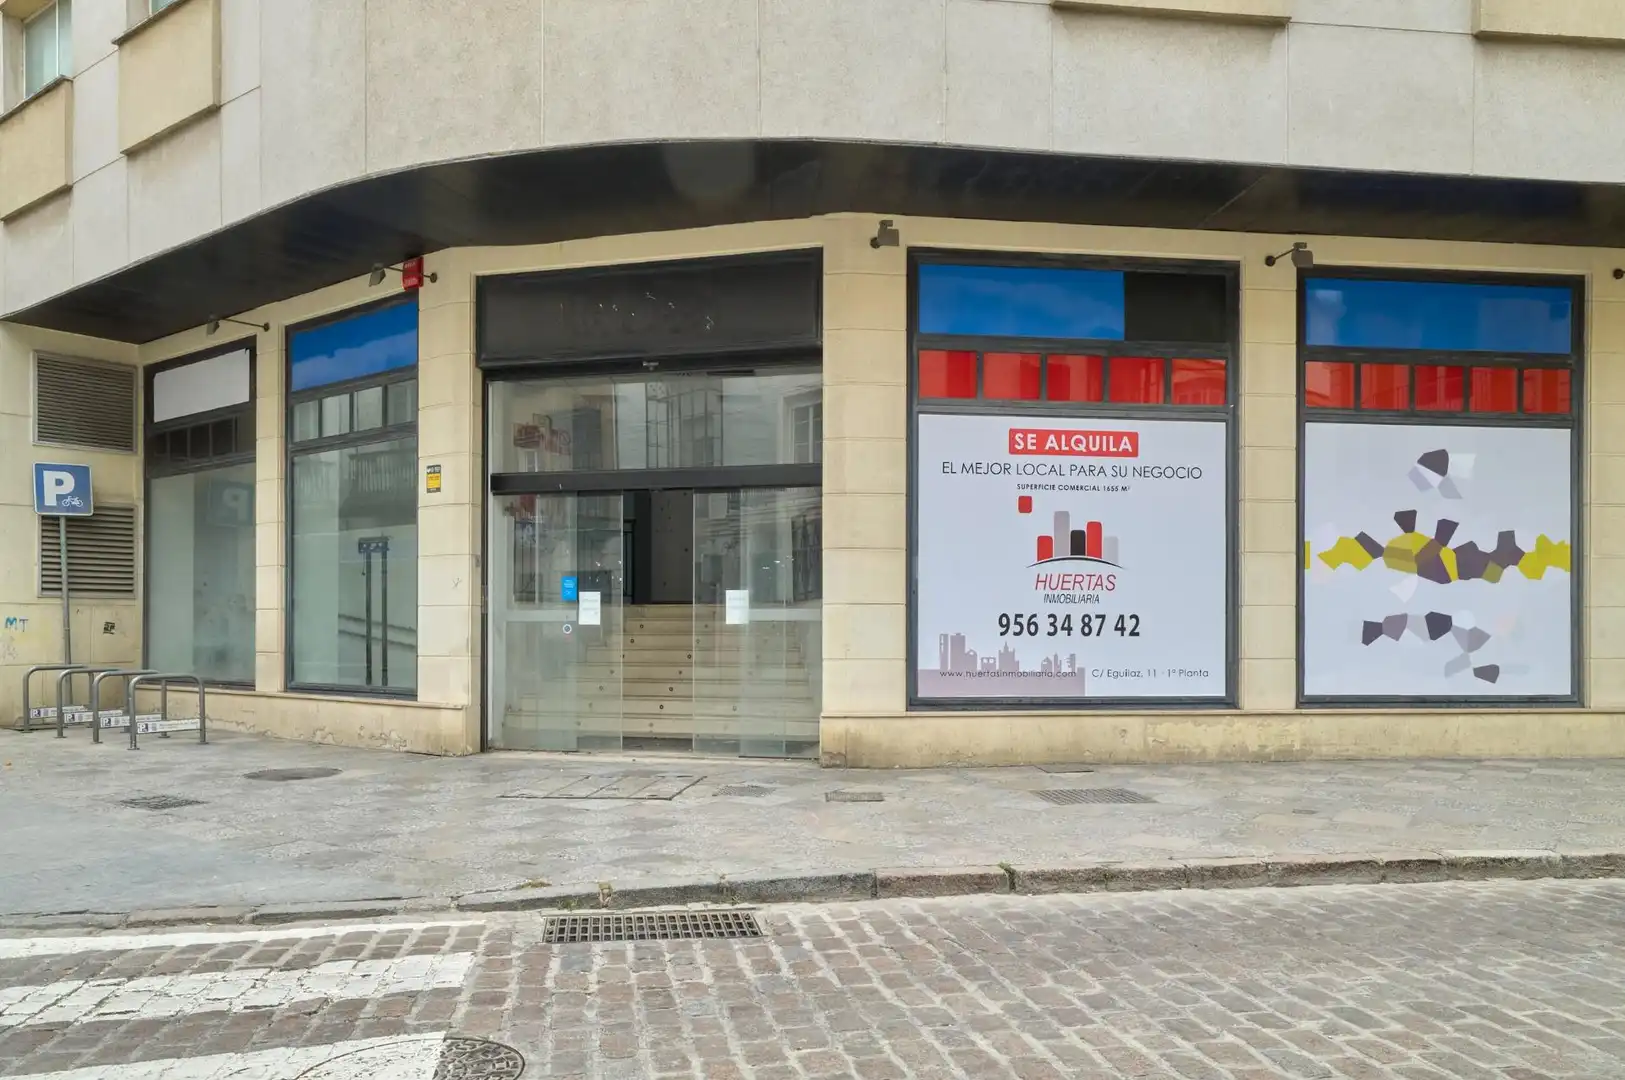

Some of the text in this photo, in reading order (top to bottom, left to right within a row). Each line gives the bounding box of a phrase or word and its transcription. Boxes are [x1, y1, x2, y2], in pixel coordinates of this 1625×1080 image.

[1014, 432, 1133, 453] SE ALQUILA
[942, 461, 1203, 480] EL MEJOR LOCAL PARA SU NEGOCIO
[43, 470, 75, 506] P
[1016, 483, 1056, 491] SUPERFICIE
[1057, 484, 1101, 492] COMERCIAL
[1034, 573, 1117, 592] HUERTAS
[1043, 593, 1100, 604] INMOBILIARIA
[998, 613, 1140, 637] 956 34 87 42
[939, 669, 1077, 678] www.huertasinmobiliaria.com
[1091, 668, 1105, 678] C/
[1147, 669, 1157, 678] 11
[1178, 668, 1209, 678] Planta
